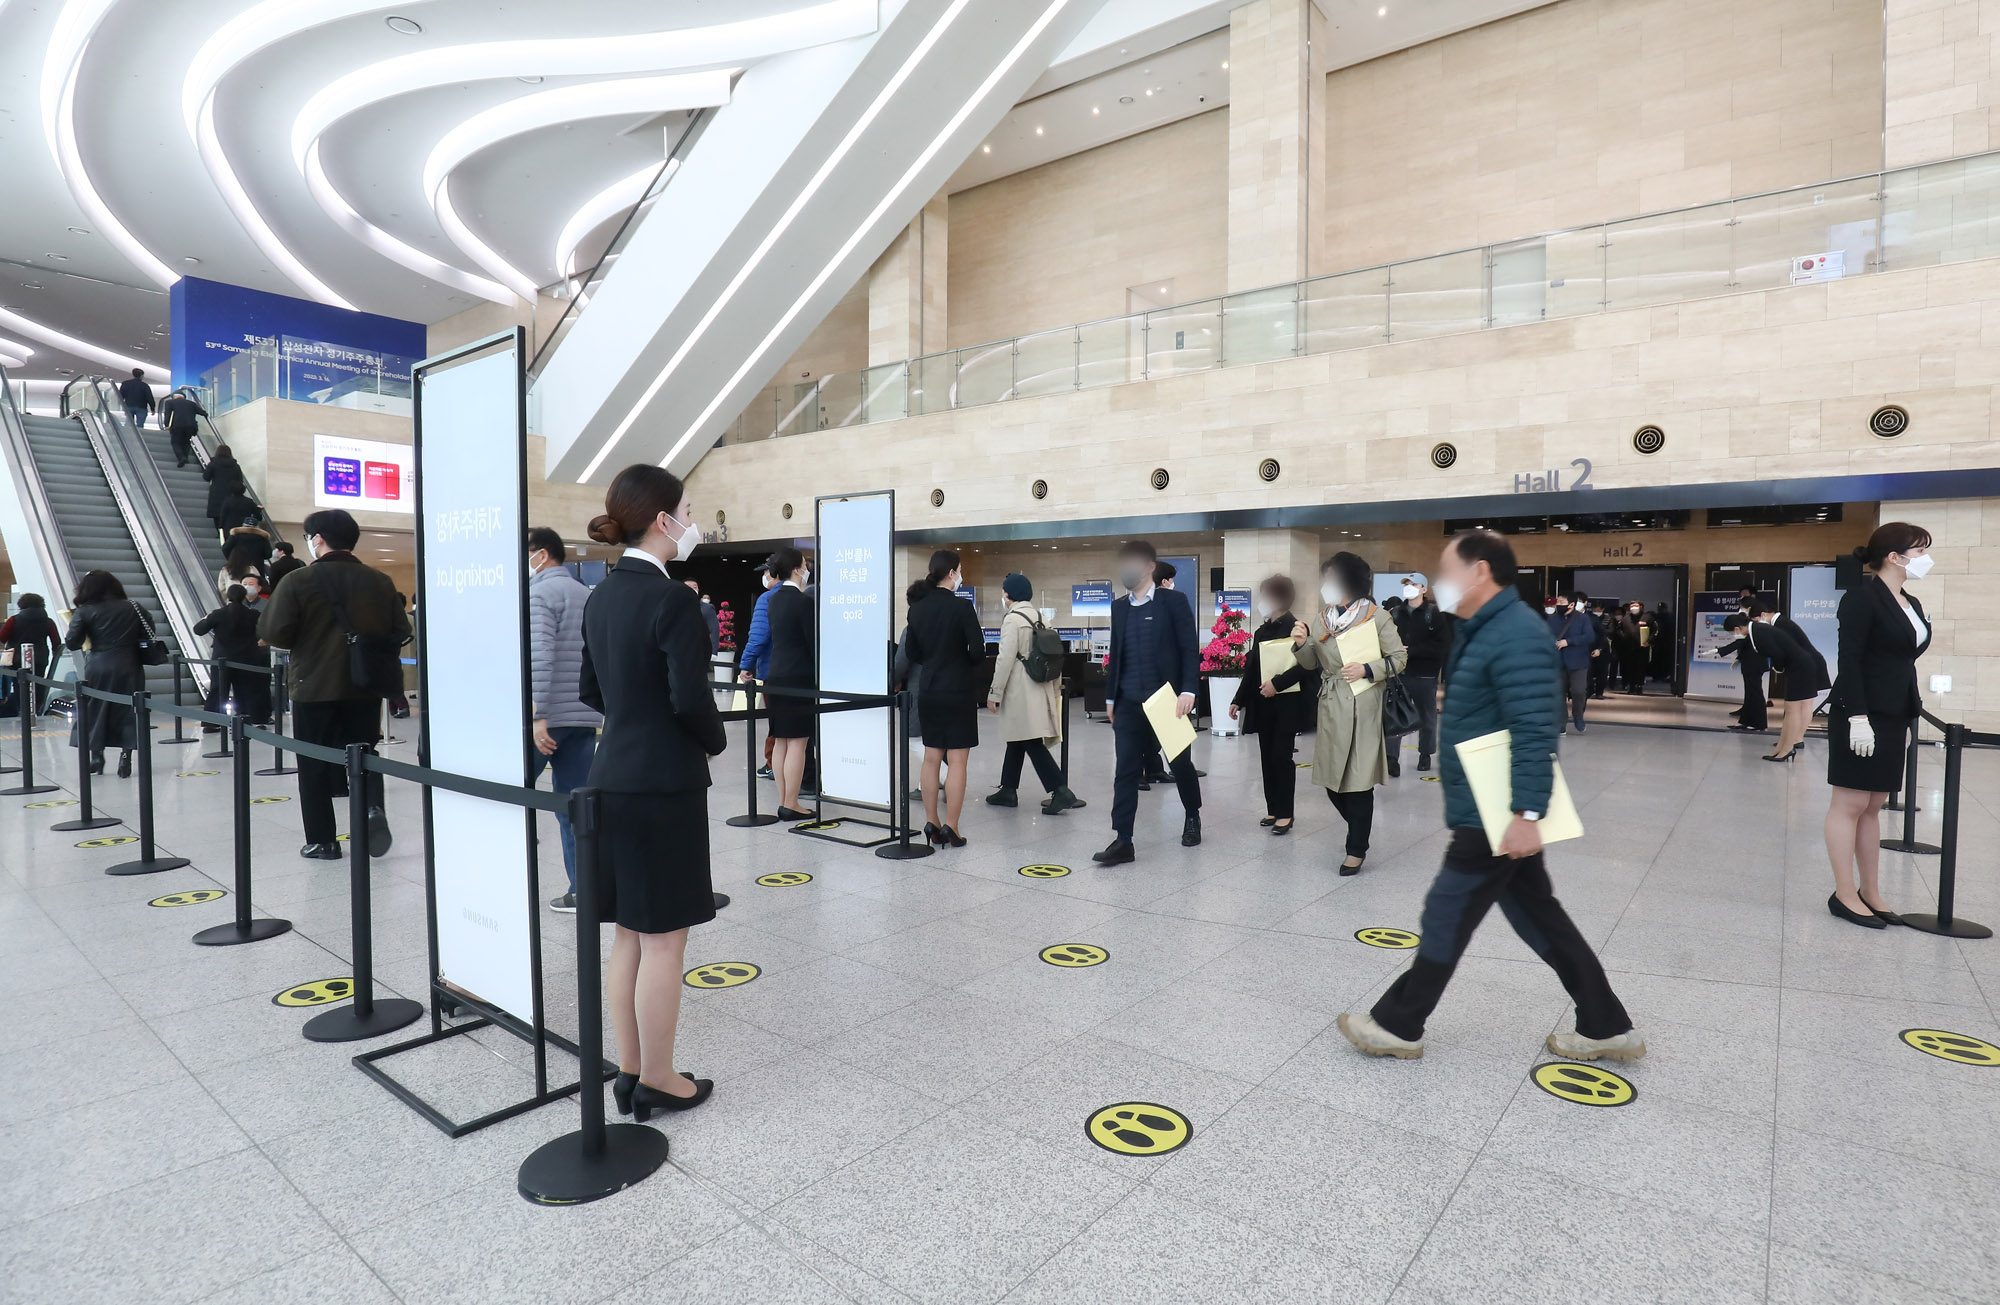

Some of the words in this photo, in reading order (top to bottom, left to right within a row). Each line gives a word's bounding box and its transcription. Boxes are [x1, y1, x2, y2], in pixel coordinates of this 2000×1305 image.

[205, 341, 222, 349] 53rd
[222, 344, 259, 357] Samsung
[305, 358, 331, 367] Annual
[331, 363, 361, 374] Meeting
[370, 368, 412, 380] Shareholder
[282, 341, 323, 357] 삼성전자
[326, 348, 384, 367] 정기주주총회
[1514, 470, 1560, 493] Hall
[1570, 458, 1593, 491] 2
[703, 531, 718, 544] Hall
[720, 524, 728, 543] 3
[1603, 547, 1629, 558] Hall
[1632, 543, 1643, 557] 2
[1075, 590, 1081, 600] 7
[1218, 595, 1224, 604] 8
